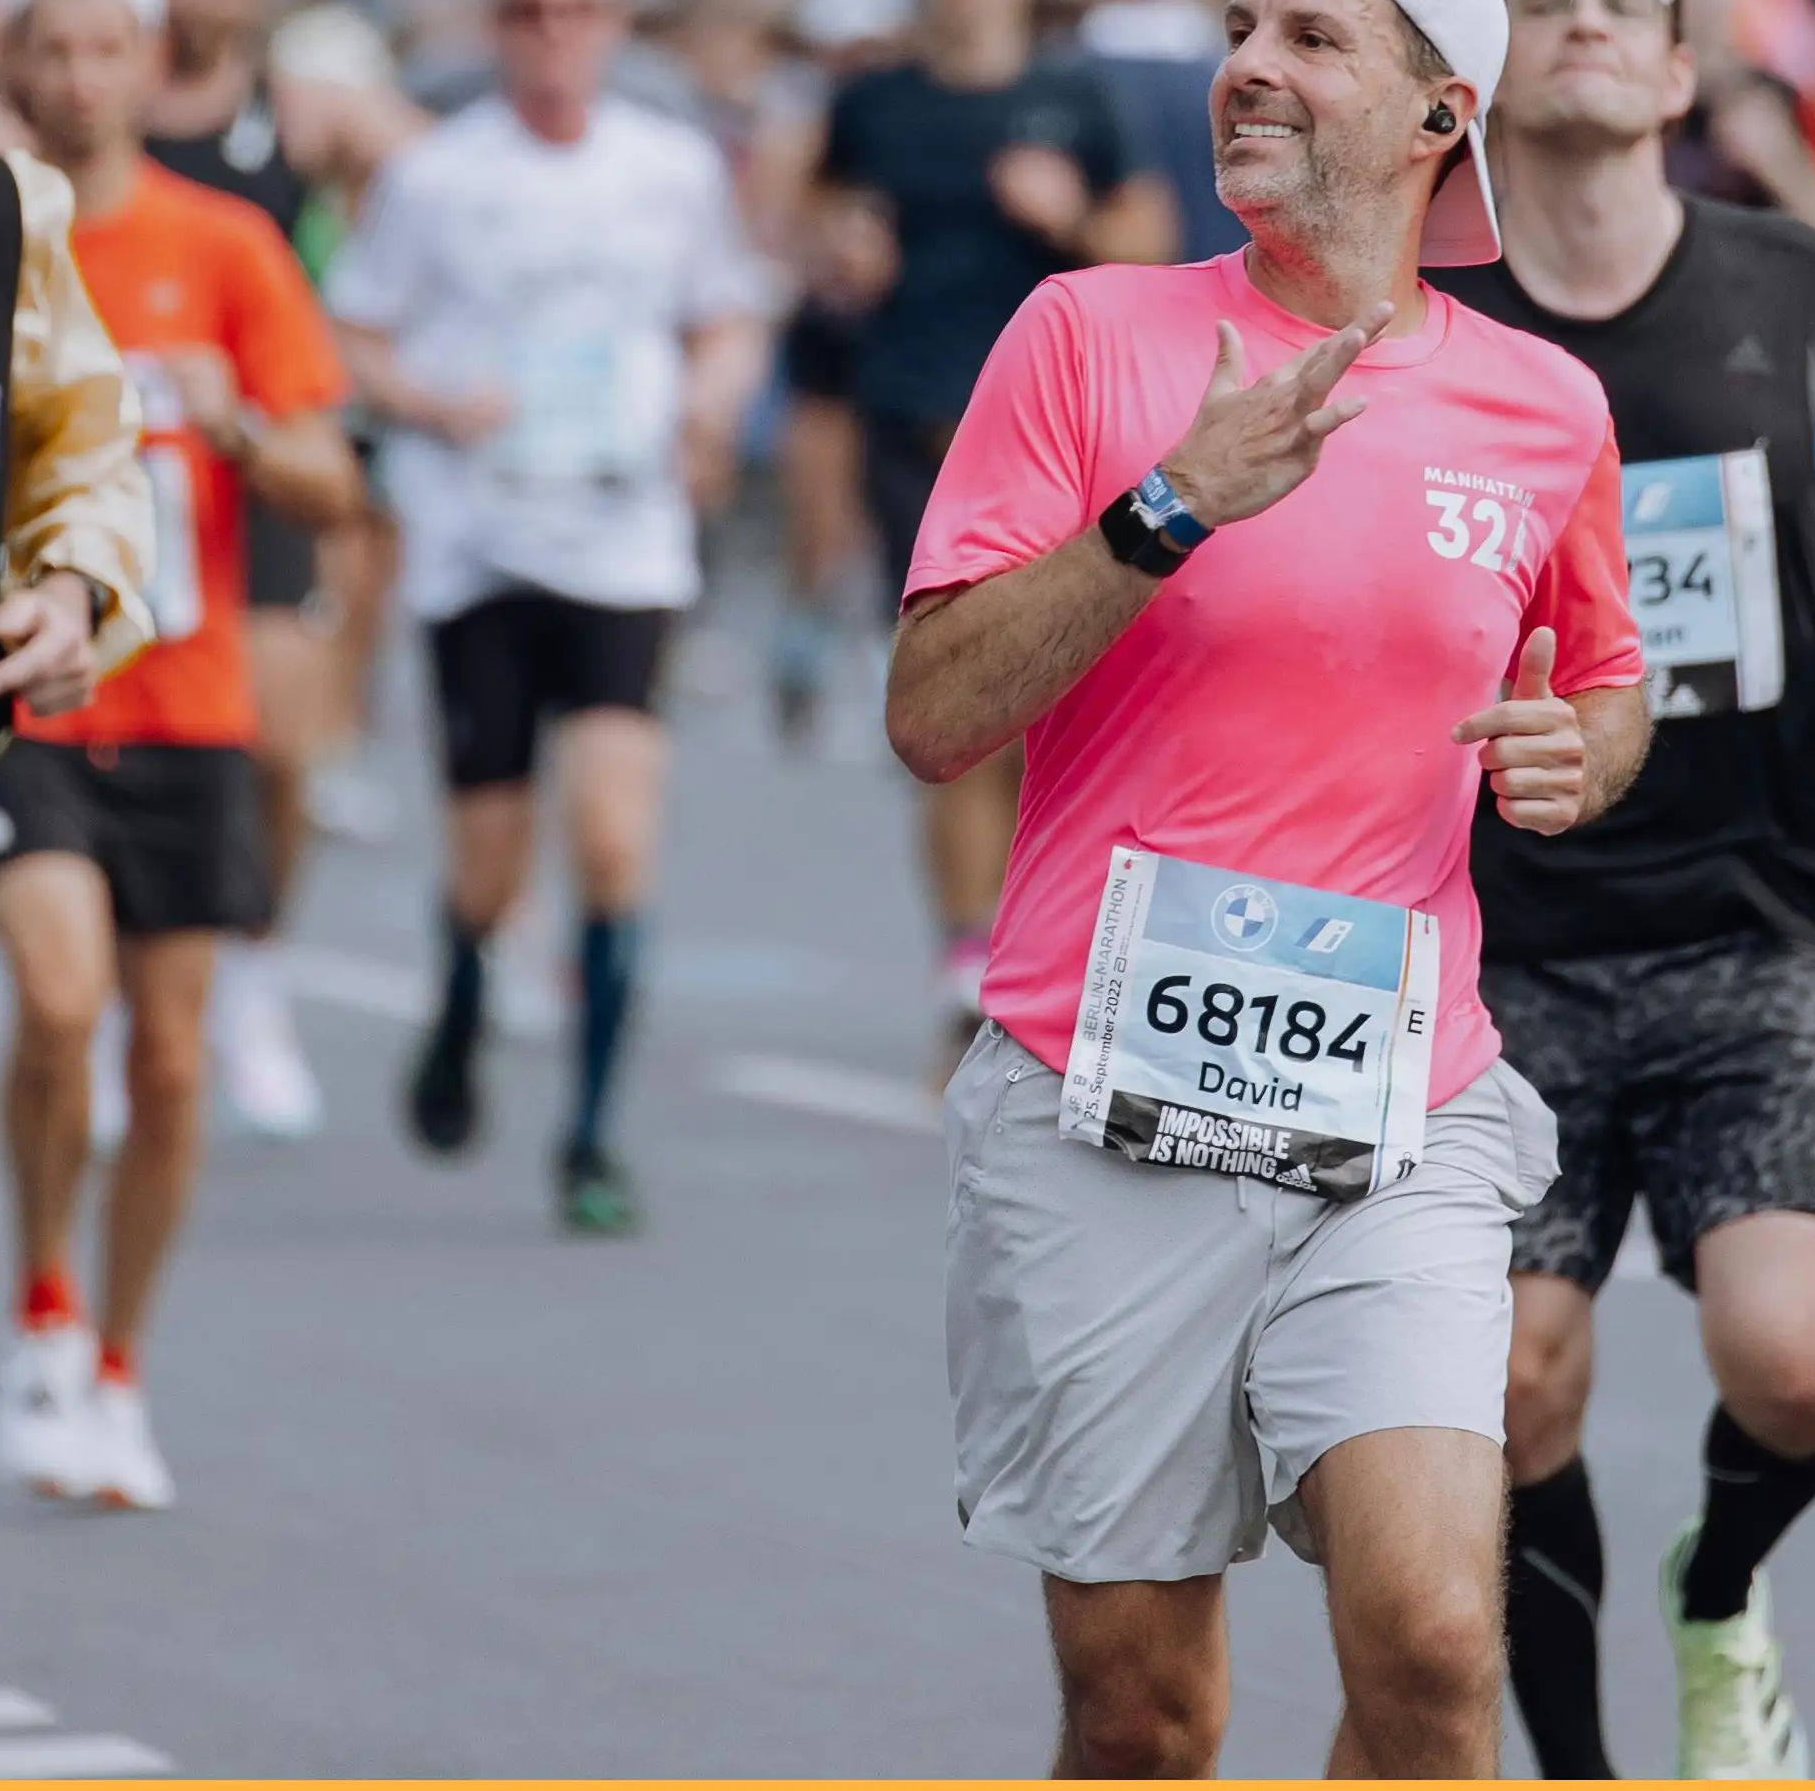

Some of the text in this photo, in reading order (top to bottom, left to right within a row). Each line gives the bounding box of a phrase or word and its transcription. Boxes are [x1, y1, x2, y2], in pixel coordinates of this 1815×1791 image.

[1423, 466, 1535, 508] MANHATTAN
[1627, 553, 1712, 605] 34
[1083, 877, 1128, 1042] BERLIN-MARATHON
[1090, 1015, 1115, 1095] September
[1104, 978, 1123, 1016] 2022
[1146, 975, 1373, 1074] 68184
[1406, 1009, 1425, 1035] E
[1198, 1061, 1304, 1112] David
[1148, 1133, 1278, 1180] IS NOTHING
[1157, 1105, 1292, 1160] IMPOSSIBLE
[1276, 1173, 1318, 1192] adidas
